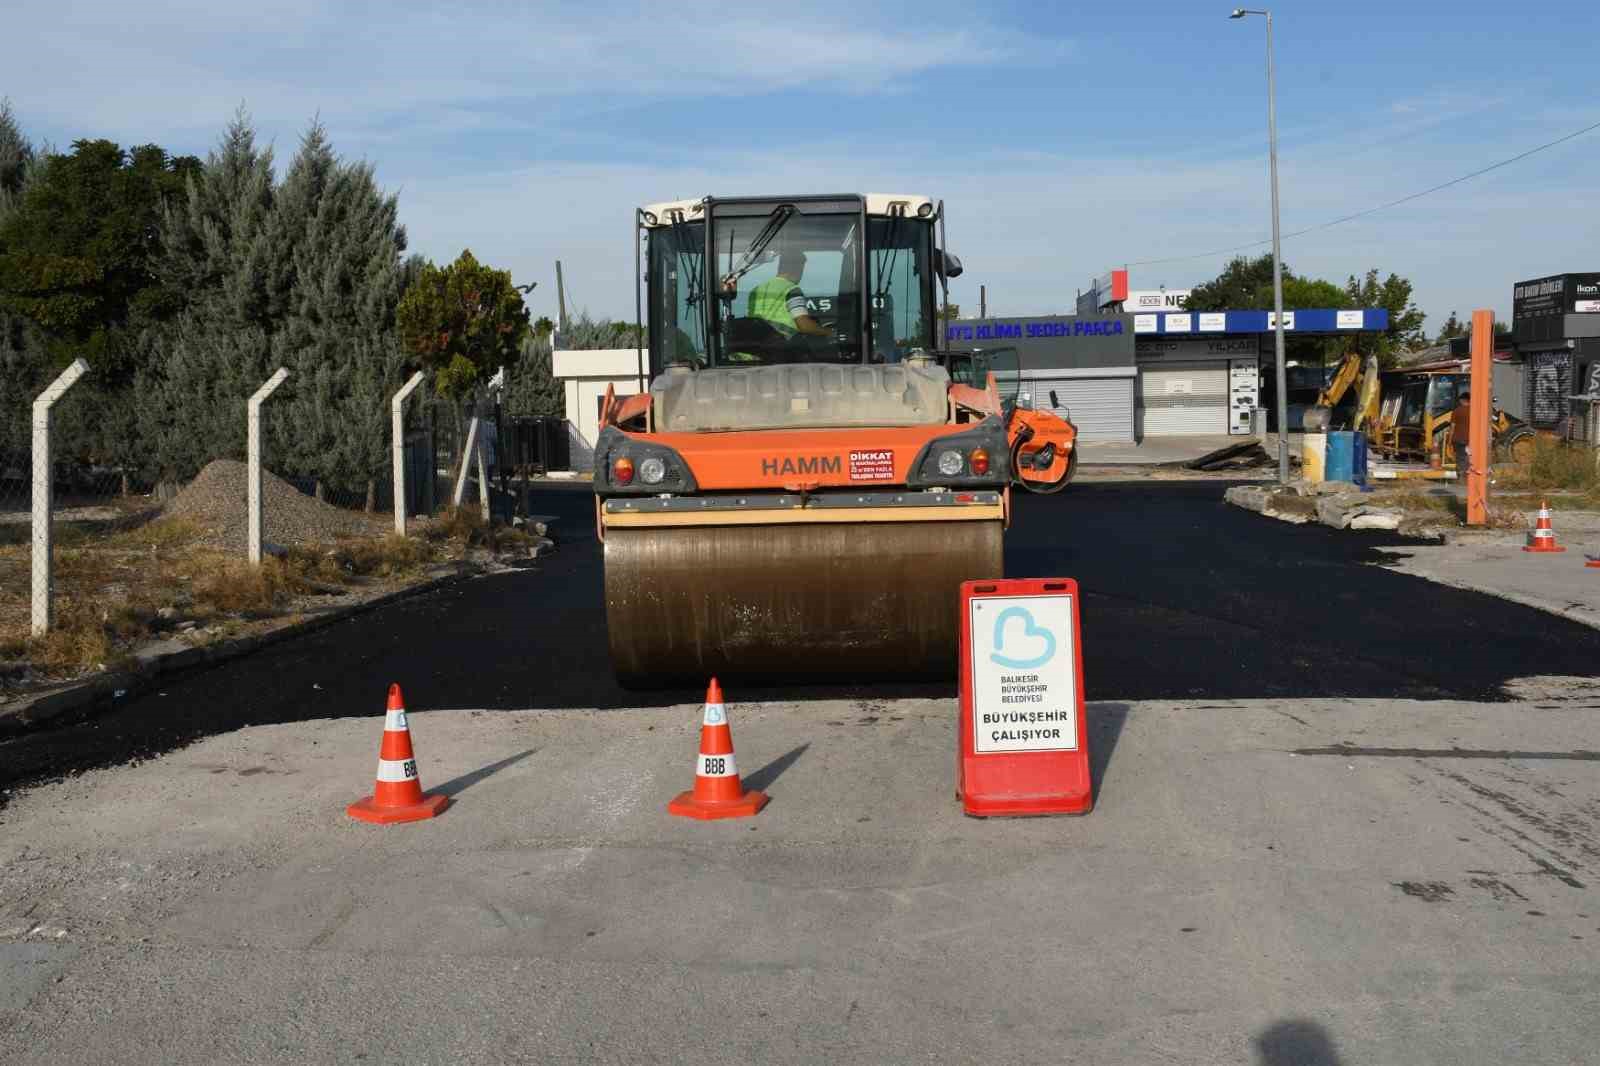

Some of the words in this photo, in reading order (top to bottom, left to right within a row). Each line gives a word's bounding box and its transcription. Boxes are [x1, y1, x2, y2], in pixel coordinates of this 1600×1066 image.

[850, 451, 892, 461] DİKKAT
[762, 456, 842, 476] HAMM
[1000, 675, 1039, 684] BALIKESİR
[1001, 684, 1048, 694] BÜYÜKŞEHİR
[1001, 694, 1043, 703] BELEDİYESİ
[983, 709, 1068, 724] BÜYÜKŞEHİR
[991, 728, 1060, 742] ÇALIŞIYOR
[705, 758, 725, 775] BBB
